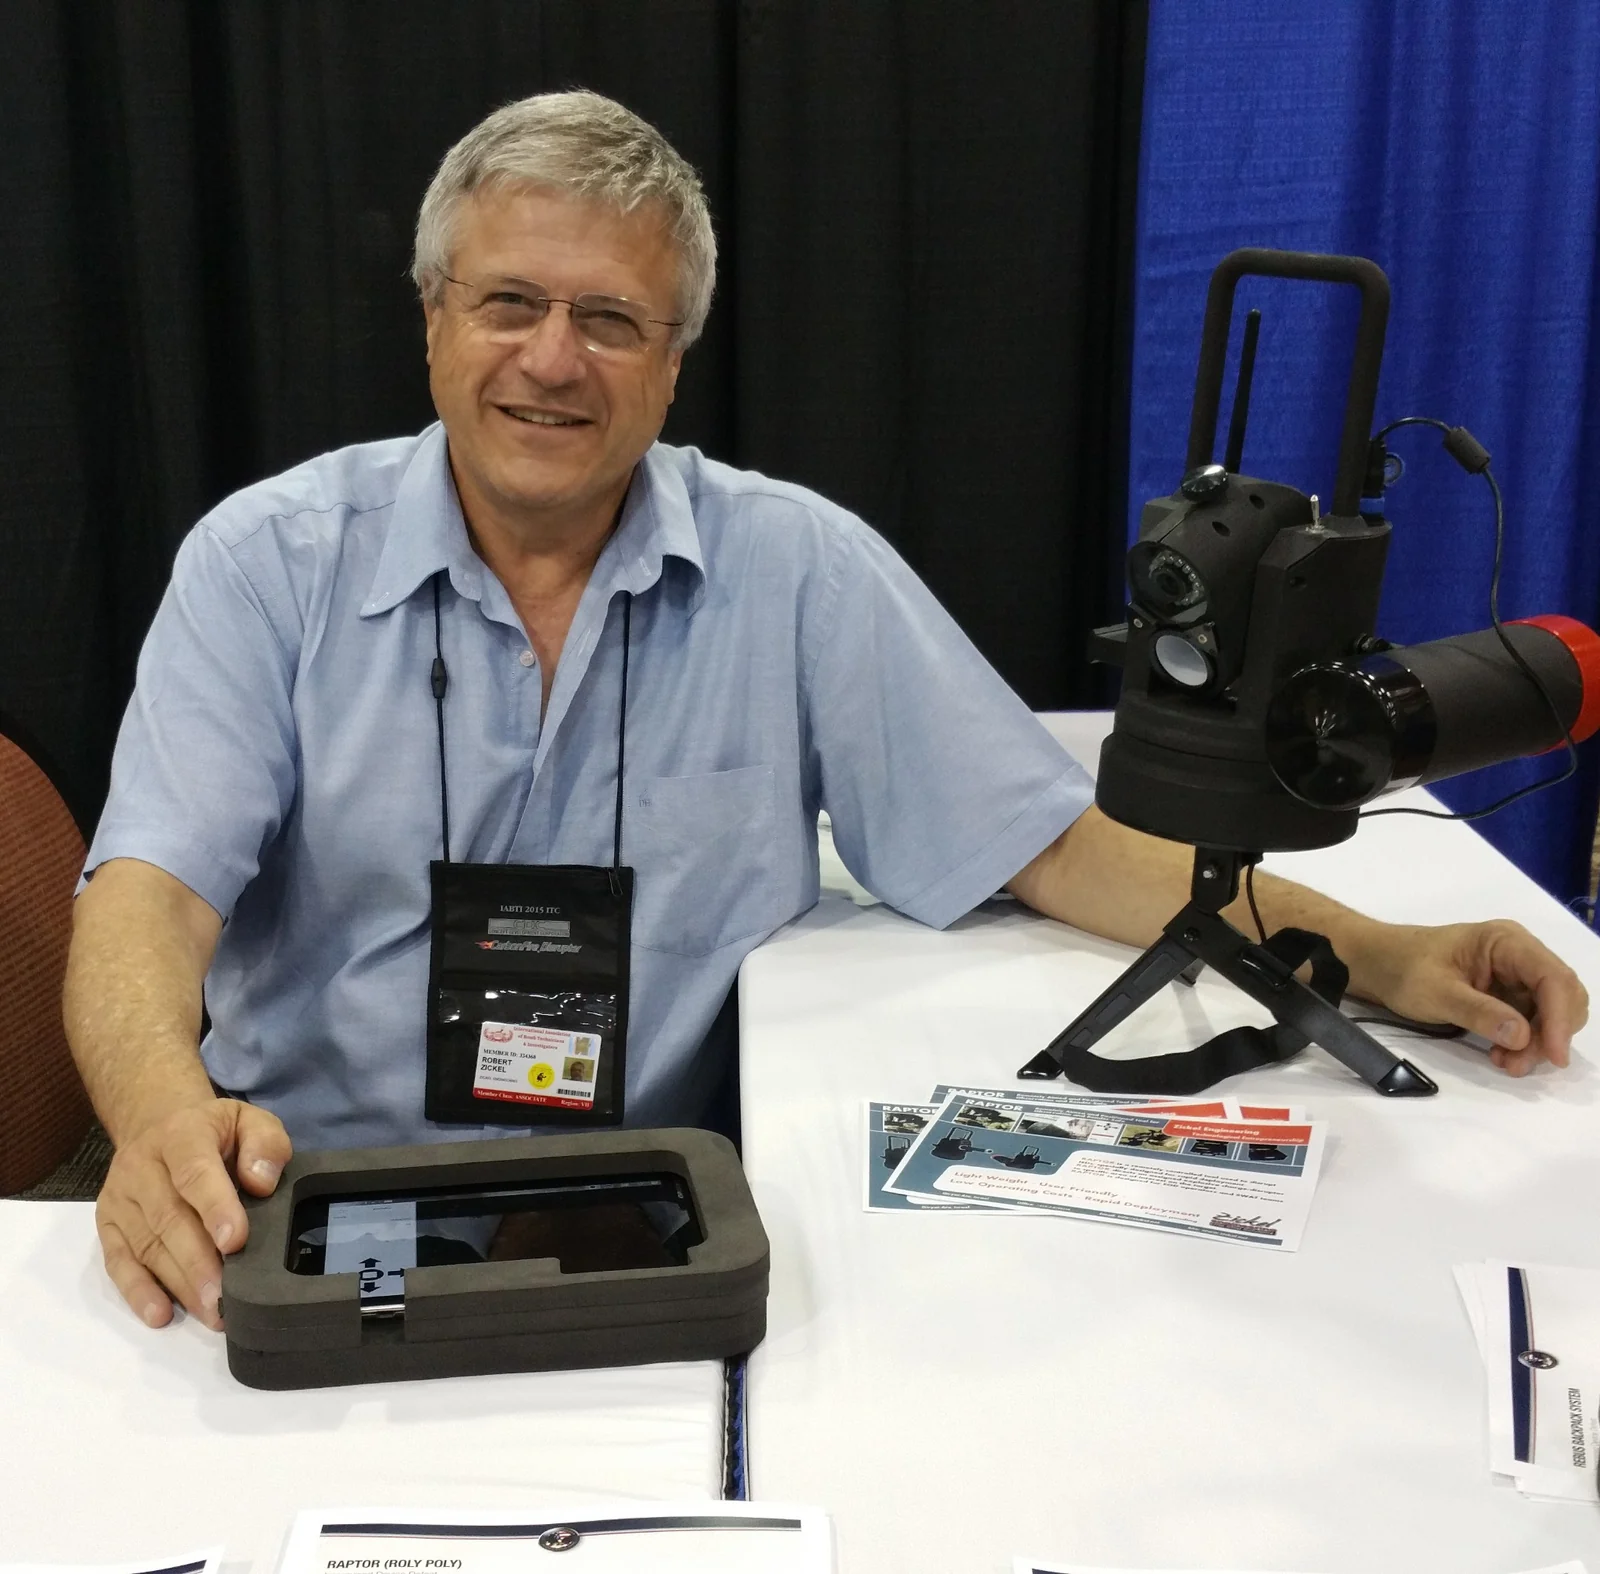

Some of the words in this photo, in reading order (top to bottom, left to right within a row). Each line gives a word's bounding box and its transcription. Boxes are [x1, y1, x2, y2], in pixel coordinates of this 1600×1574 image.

[500, 905, 523, 913] IABTI
[525, 906, 544, 914] 2015
[483, 1048, 509, 1057] MEMBER
[482, 1056, 513, 1066] ROBERT
[480, 1064, 507, 1073] ZICKEL
[477, 1090, 498, 1098] Member
[515, 1094, 547, 1103] ASSOCIATE
[965, 1099, 1024, 1112] RAPTOR
[1173, 1123, 1201, 1131] Zickel
[1203, 1126, 1260, 1136] Engineering
[1192, 1131, 1241, 1140] Technological
[1081, 1157, 1115, 1165] RAPTOR
[1076, 1163, 1110, 1171] RAPTOR
[1071, 1169, 1105, 1177] RAPTOR
[954, 1171, 983, 1179] Light
[986, 1175, 1028, 1184] Weight
[1039, 1182, 1066, 1190] User
[1069, 1186, 1119, 1198] Friendly
[950, 1178, 974, 1186] Low
[978, 1181, 1039, 1194] Operating
[1042, 1190, 1073, 1198] Costs
[1085, 1195, 1121, 1205] Rapid
[1124, 1201, 1200, 1218] Deployment
[1212, 1211, 1282, 1228] Zickel
[1568, 1387, 1582, 1412] SYSTEM
[1569, 1412, 1585, 1446] BACKPACK
[327, 1559, 380, 1569] RAPTOR
[384, 1559, 422, 1569] (ROLY
[425, 1559, 462, 1569] POLY)
